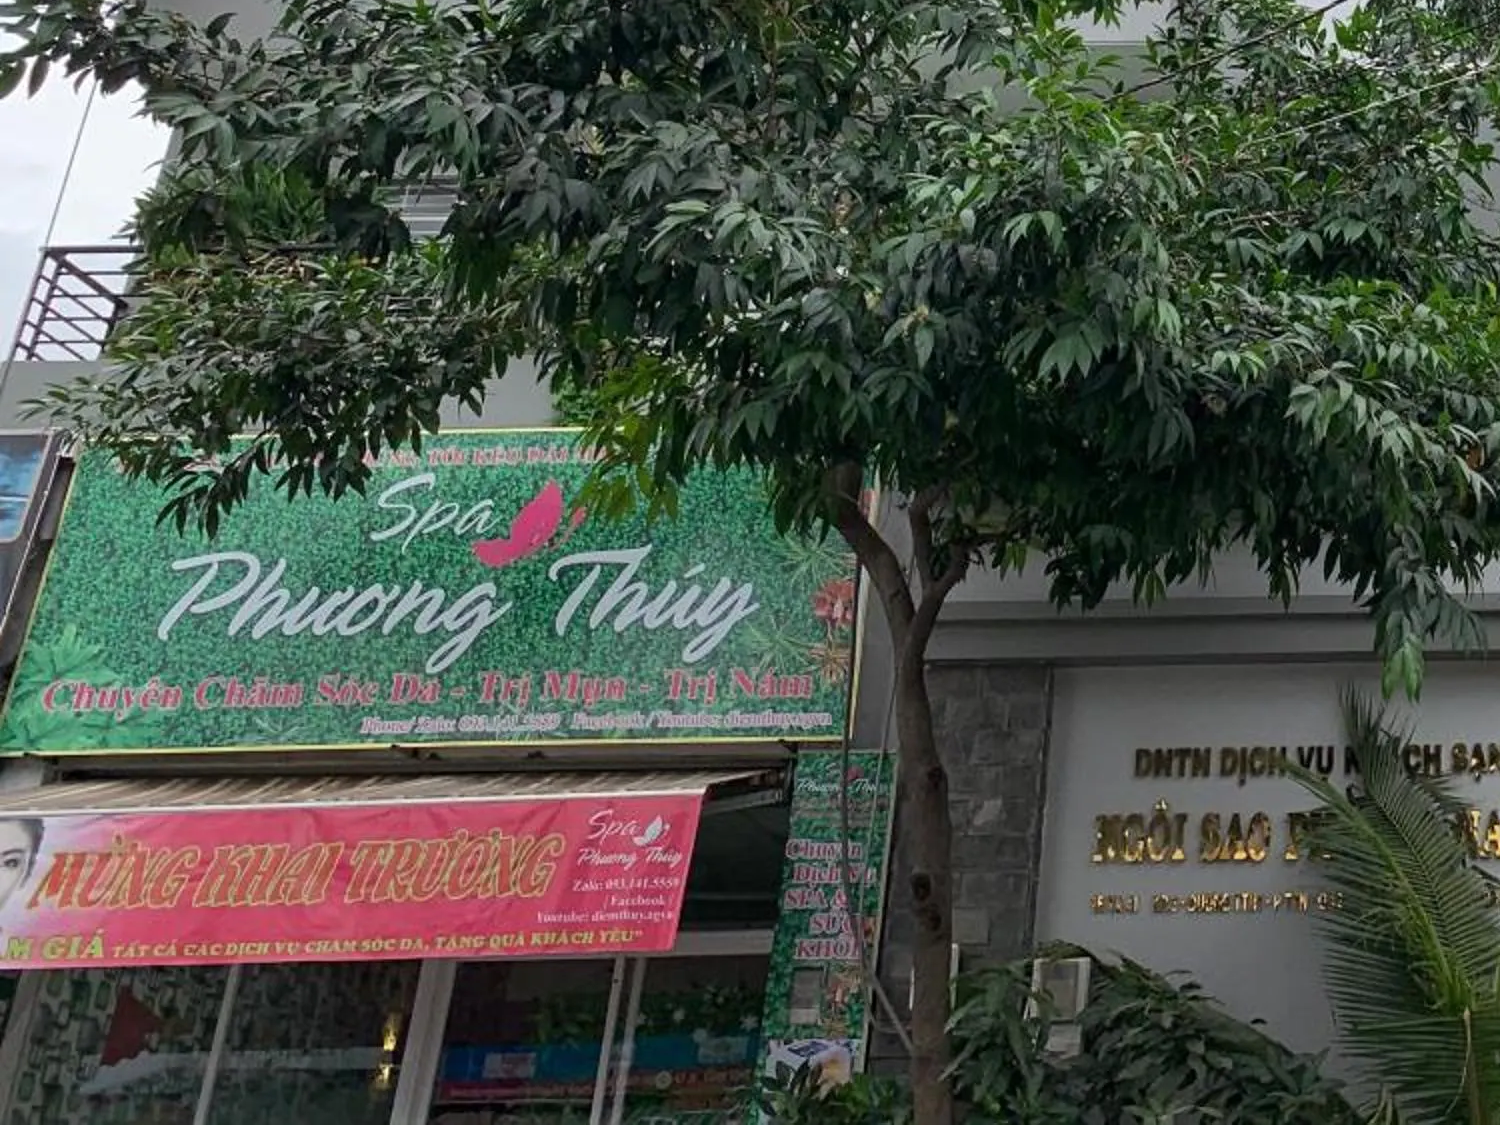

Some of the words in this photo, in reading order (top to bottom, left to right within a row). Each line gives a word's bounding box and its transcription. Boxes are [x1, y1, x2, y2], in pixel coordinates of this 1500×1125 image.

[371, 475, 504, 552] Spa
[157, 551, 513, 673] Phương
[548, 544, 760, 663] Thúy
[42, 676, 183, 721] Chuyên
[194, 675, 303, 709] Chăm
[314, 672, 379, 706] Sóc
[388, 673, 440, 704] Da
[476, 670, 530, 708] Trị
[664, 667, 718, 705] Trị
[728, 664, 814, 701] Nám
[1134, 746, 1213, 778] DNTN
[1220, 744, 1288, 787] DỊCH
[587, 808, 640, 846] Spa
[1091, 796, 1188, 862] NGÔI
[1199, 811, 1272, 862] SAO
[192, 841, 346, 908] KHAI
[0, 936, 35, 961] M
[40, 927, 105, 961] GIÁ
